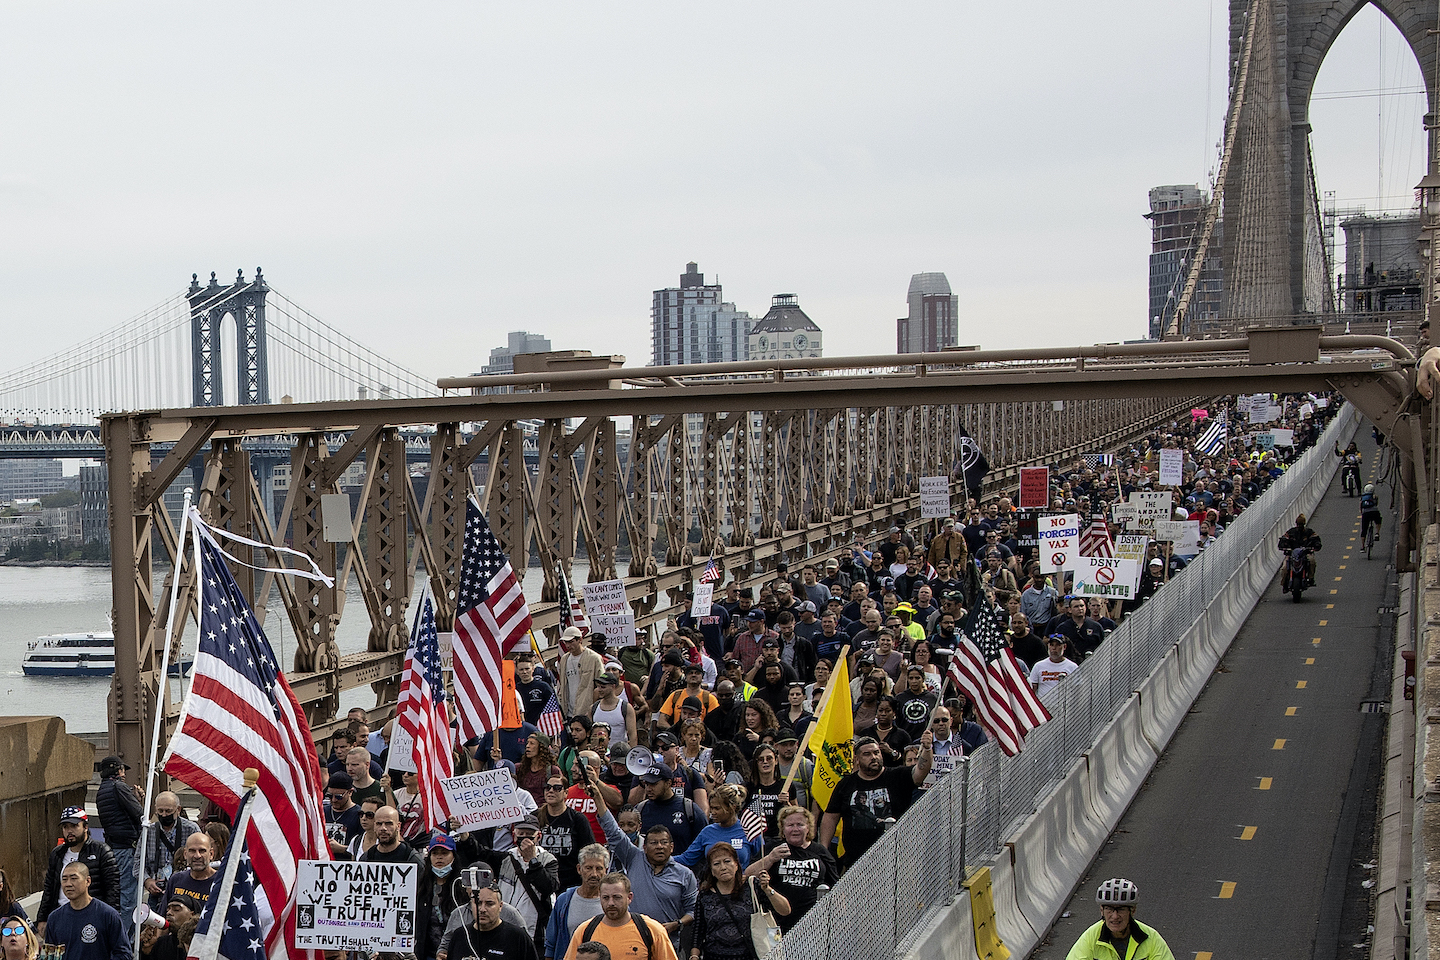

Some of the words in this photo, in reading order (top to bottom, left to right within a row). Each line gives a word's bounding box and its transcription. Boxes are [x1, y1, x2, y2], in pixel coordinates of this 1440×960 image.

[1050, 518, 1066, 528] NO
[1138, 518, 1155, 526] NOT
[1039, 528, 1078, 539] FORCED
[1048, 539, 1069, 549] VAX
[1120, 535, 1143, 544] DSNY
[1090, 558, 1121, 568] DSNY
[1083, 583, 1130, 597] MANDATE!
[610, 591, 622, 600] OUT
[598, 601, 625, 613] TYRANNY
[596, 617, 609, 626] WE
[611, 617, 630, 625] WILL
[605, 626, 626, 635] NOT
[606, 635, 629, 644] OMPLY
[440, 770, 510, 792] YESTERDAY'S
[452, 784, 513, 803] HEROES
[463, 795, 506, 810] TODAY'S
[455, 806, 521, 827] UNEMPLOYED
[780, 858, 820, 871] LIBERTY
[794, 868, 806, 876] OR
[314, 880, 338, 893] NO
[343, 894, 373, 908] SEE
[383, 896, 409, 909] THE
[317, 919, 347, 927] OUTSOURCE
[360, 921, 385, 929] OFFICIAL
[316, 935, 348, 946] TRUTH
[347, 937, 370, 946] SHALL
